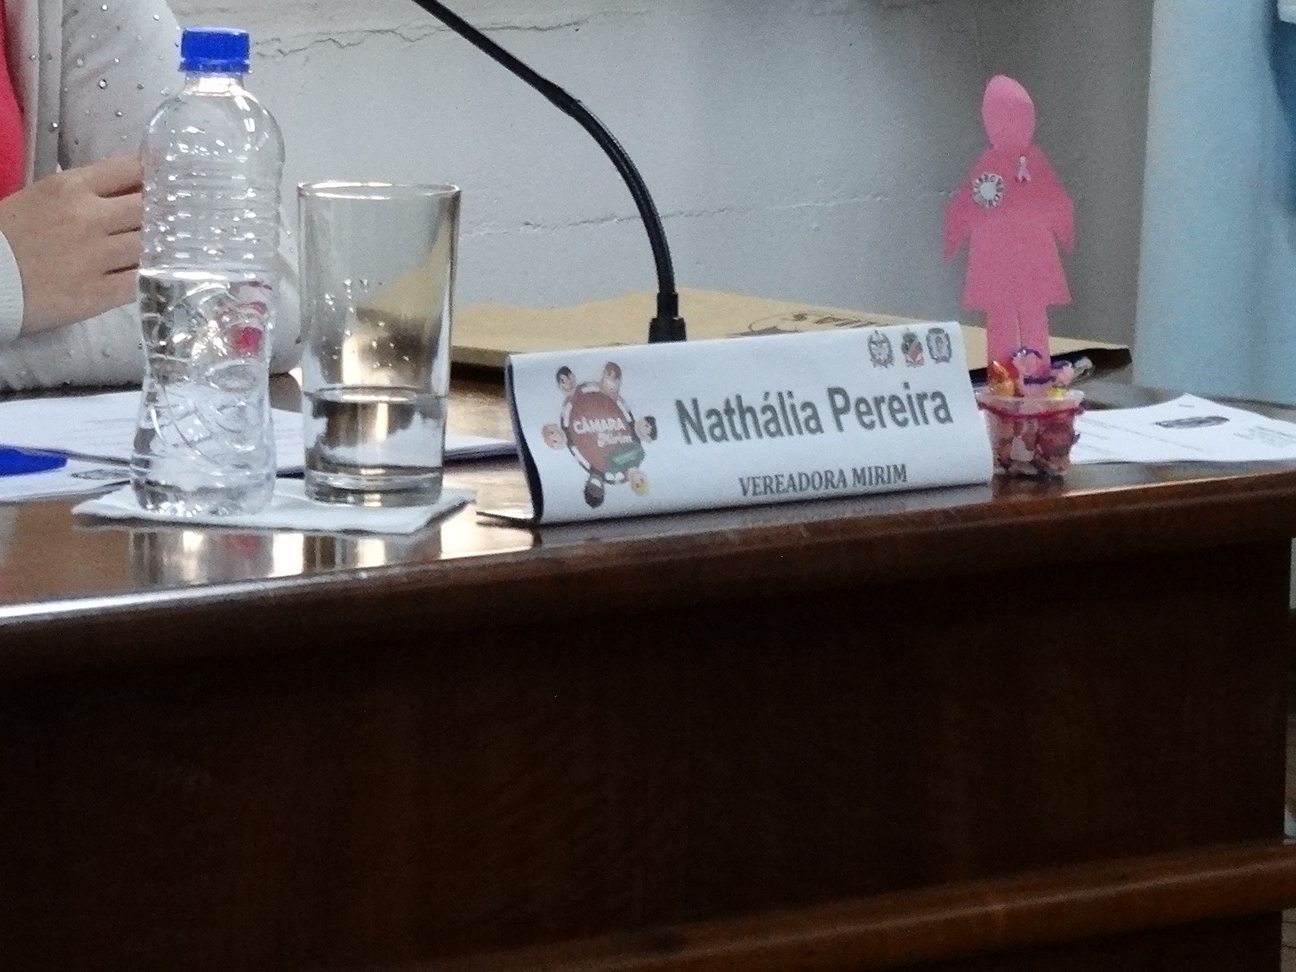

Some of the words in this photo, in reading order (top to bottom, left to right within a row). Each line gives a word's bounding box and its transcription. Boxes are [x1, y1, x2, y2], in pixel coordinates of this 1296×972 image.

[675, 389, 824, 445] Nathália
[827, 381, 954, 432] Pereira
[738, 468, 847, 497] VEREADORA
[851, 462, 908, 487] MIRIM
